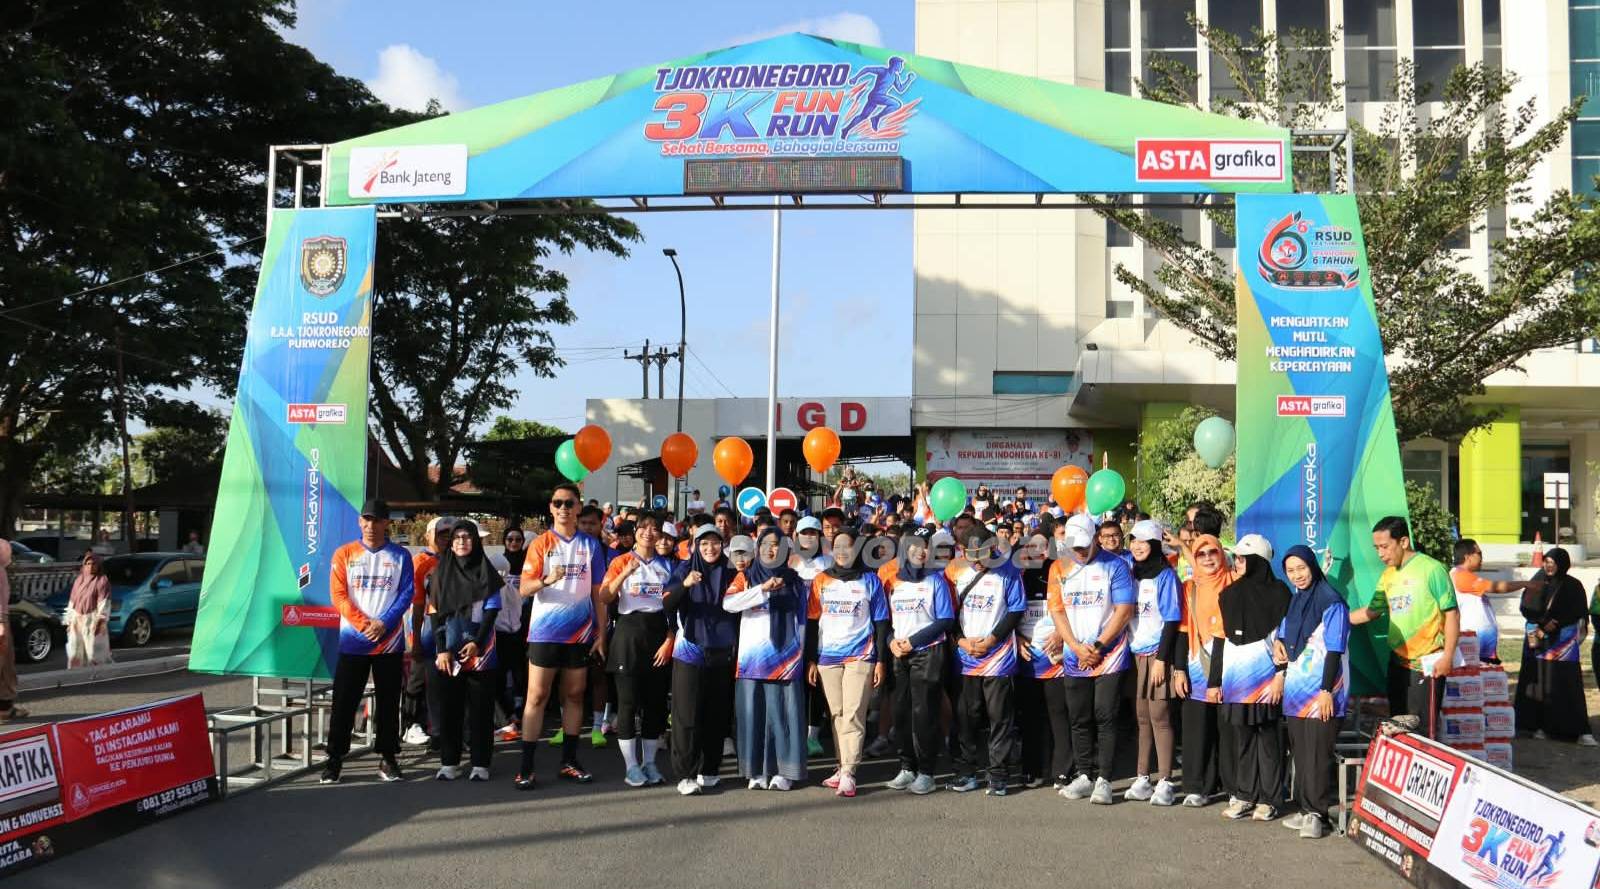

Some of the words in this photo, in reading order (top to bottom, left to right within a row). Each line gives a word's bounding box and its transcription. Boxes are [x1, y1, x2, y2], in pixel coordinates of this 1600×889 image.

[656, 64, 850, 90] TJOKRONEGORO
[773, 91, 845, 113] FUN
[645, 91, 773, 139] 3K
[766, 114, 840, 137] RUN
[662, 142, 704, 155] Sehat
[773, 141, 834, 155] Bahagia
[836, 141, 898, 152] Bersama
[1141, 149, 1207, 170] ASTA
[1214, 150, 1276, 171] grafika
[380, 170, 410, 184] Bank
[413, 170, 451, 186] Jateng
[1315, 231, 1352, 241] RSUD
[1312, 256, 1319, 264] 6
[1322, 256, 1355, 264] TAHUN
[303, 312, 338, 324] RSUD
[1270, 316, 1349, 327] MENGUATKAN
[298, 326, 370, 338] TJOKRONEGORO
[288, 340, 350, 349] PURWOREJO
[1265, 346, 1356, 358] MENGHADIRKAN
[1270, 361, 1352, 372] KEPERCAYAAN
[290, 406, 316, 419] ASTA
[318, 407, 344, 419] grafika
[1280, 401, 1310, 411] ASTA
[1313, 401, 1342, 411] grafika
[958, 450, 993, 459] REPUBLIK
[995, 450, 1038, 459] INDONESIA
[307, 448, 320, 556] wekaweka
[89, 728, 107, 742] TAG
[109, 712, 151, 736] ACARAMU
[94, 744, 106, 756] DI
[106, 731, 158, 752] INSTAGRAM
[157, 722, 180, 737] KAMI
[1373, 745, 1409, 789] ASTA
[1406, 762, 1449, 809] GRAFIKA
[143, 795, 160, 810] 081
[19, 803, 64, 827] KONVEKSI
[1473, 798, 1543, 843] TJOKRONEGORO
[1462, 817, 1511, 865] 3K
[1507, 837, 1536, 863] FUN
[1500, 853, 1529, 879] RUN
